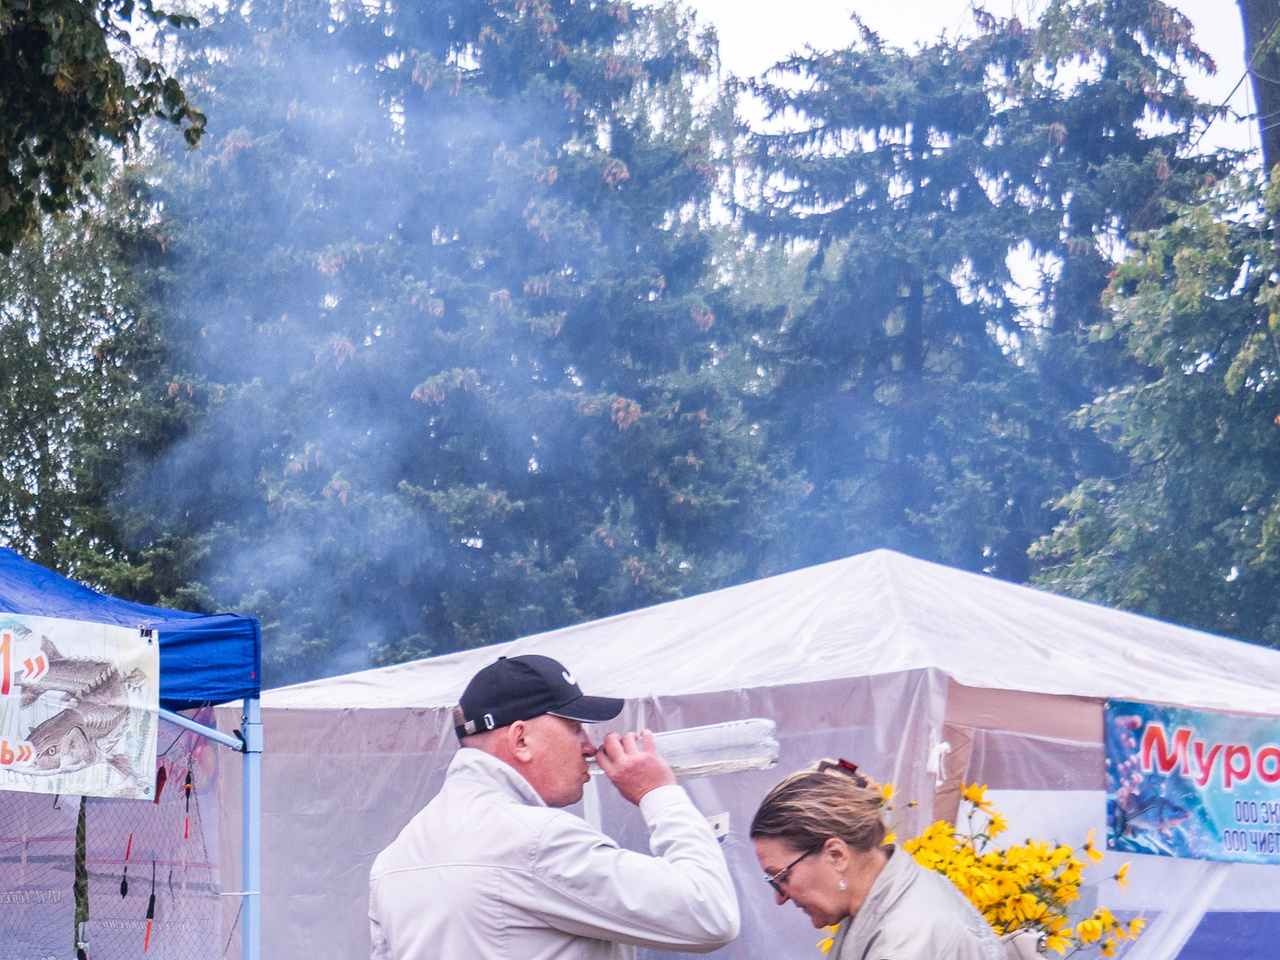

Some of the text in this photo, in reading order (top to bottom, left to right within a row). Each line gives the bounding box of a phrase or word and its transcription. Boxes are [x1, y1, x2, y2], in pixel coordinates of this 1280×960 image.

[1234, 800, 1280, 825] ООО ЭК
[1224, 830, 1248, 851] ООО
